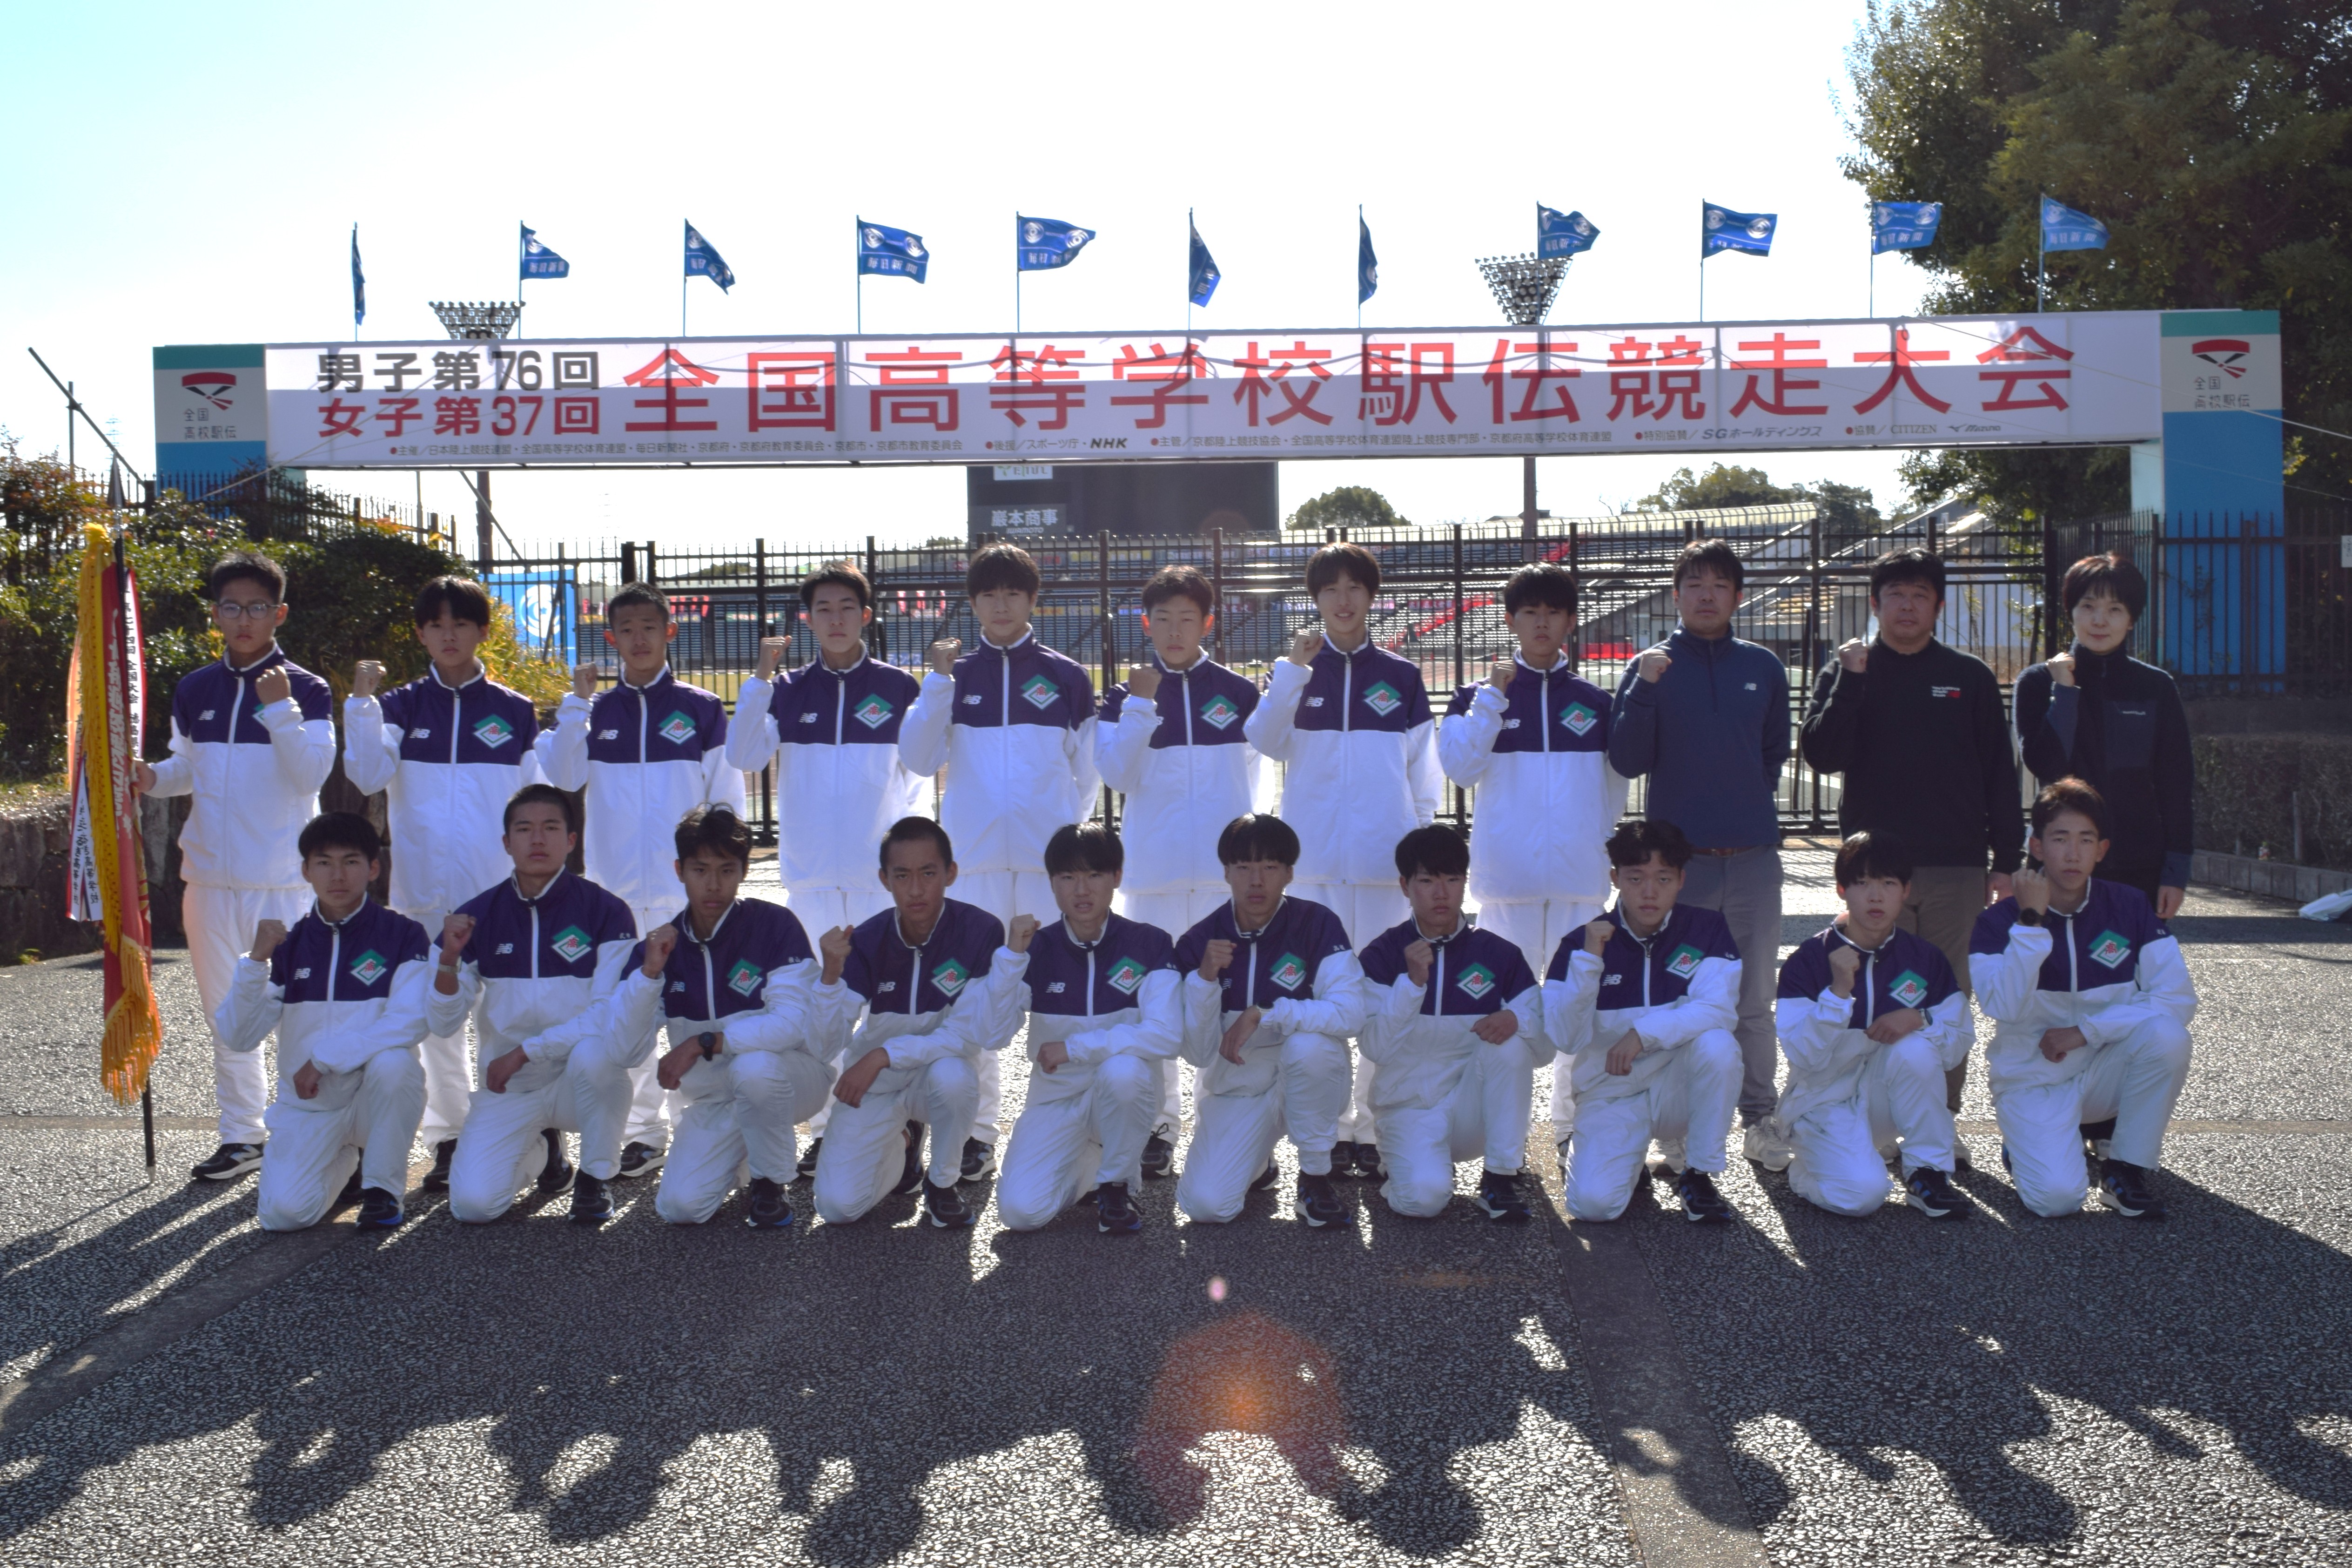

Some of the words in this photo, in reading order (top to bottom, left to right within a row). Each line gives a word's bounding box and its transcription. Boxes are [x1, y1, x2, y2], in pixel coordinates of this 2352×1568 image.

[317, 350, 599, 393] 男子第76回
[623, 326, 2074, 433] 全国高等学校駅伝競走大会
[2194, 376, 2221, 390] 全国
[2194, 394, 2251, 409] 高校駅伝
[184, 408, 209, 421] 全国
[317, 396, 600, 438] 女子第37回
[184, 425, 237, 439] 高校駅伝
[1890, 424, 1937, 434] CITIZEN
